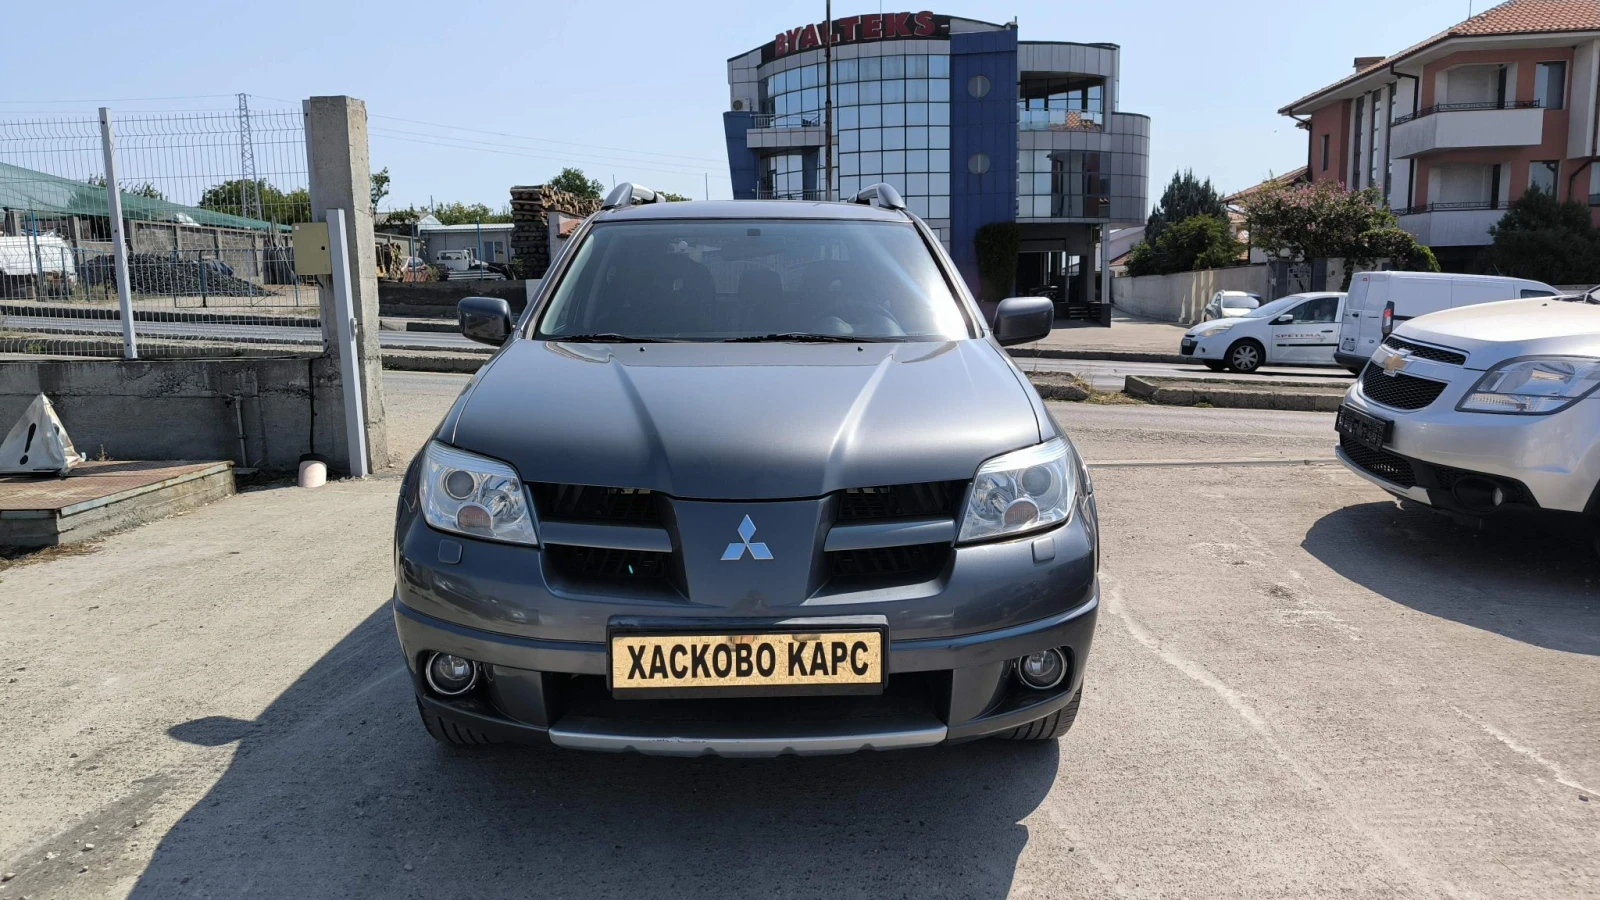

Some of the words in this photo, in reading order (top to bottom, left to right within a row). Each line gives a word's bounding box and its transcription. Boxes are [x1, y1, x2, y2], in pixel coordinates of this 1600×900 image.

[775, 10, 936, 57] BYALTEKS
[627, 643, 776, 679] ХАСКОВО
[788, 641, 869, 676] КАРС
